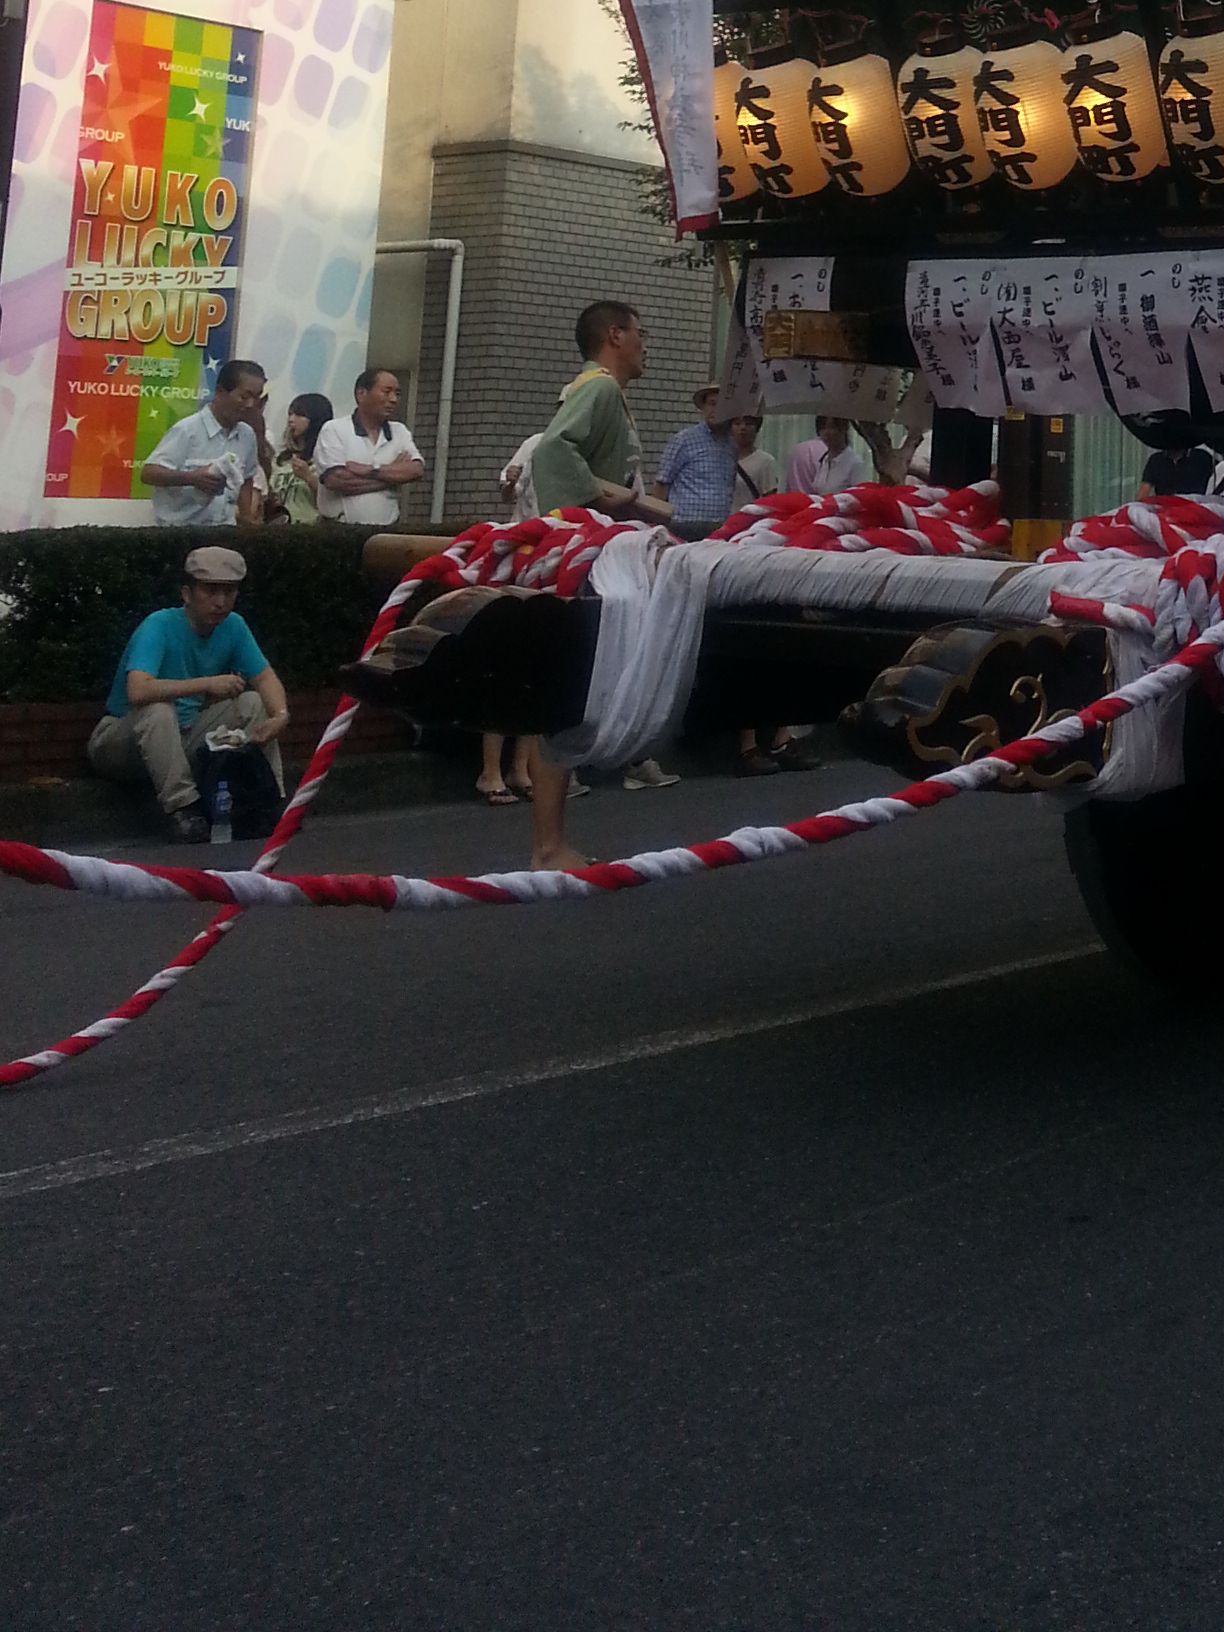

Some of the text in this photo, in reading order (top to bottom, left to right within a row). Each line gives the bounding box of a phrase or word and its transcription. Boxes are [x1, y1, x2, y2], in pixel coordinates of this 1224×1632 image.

[185, 66, 214, 79] LUCKY
[215, 71, 247, 85] GROUP
[901, 67, 975, 184] 大門町
[1061, 54, 1141, 176] 大門町
[79, 158, 237, 231] YUKO
[74, 219, 233, 268] LUCKY
[70, 270, 226, 287] ユーコーラッキーグループ
[816, 269, 828, 292] のし
[980, 270, 992, 295] のし
[1073, 268, 1086, 294] のし
[1171, 263, 1182, 289] のし
[67, 287, 228, 347] GROUP
[68, 381, 210, 399] YUKO LUCKY GROUP
[122, 460, 146, 468] YUK
